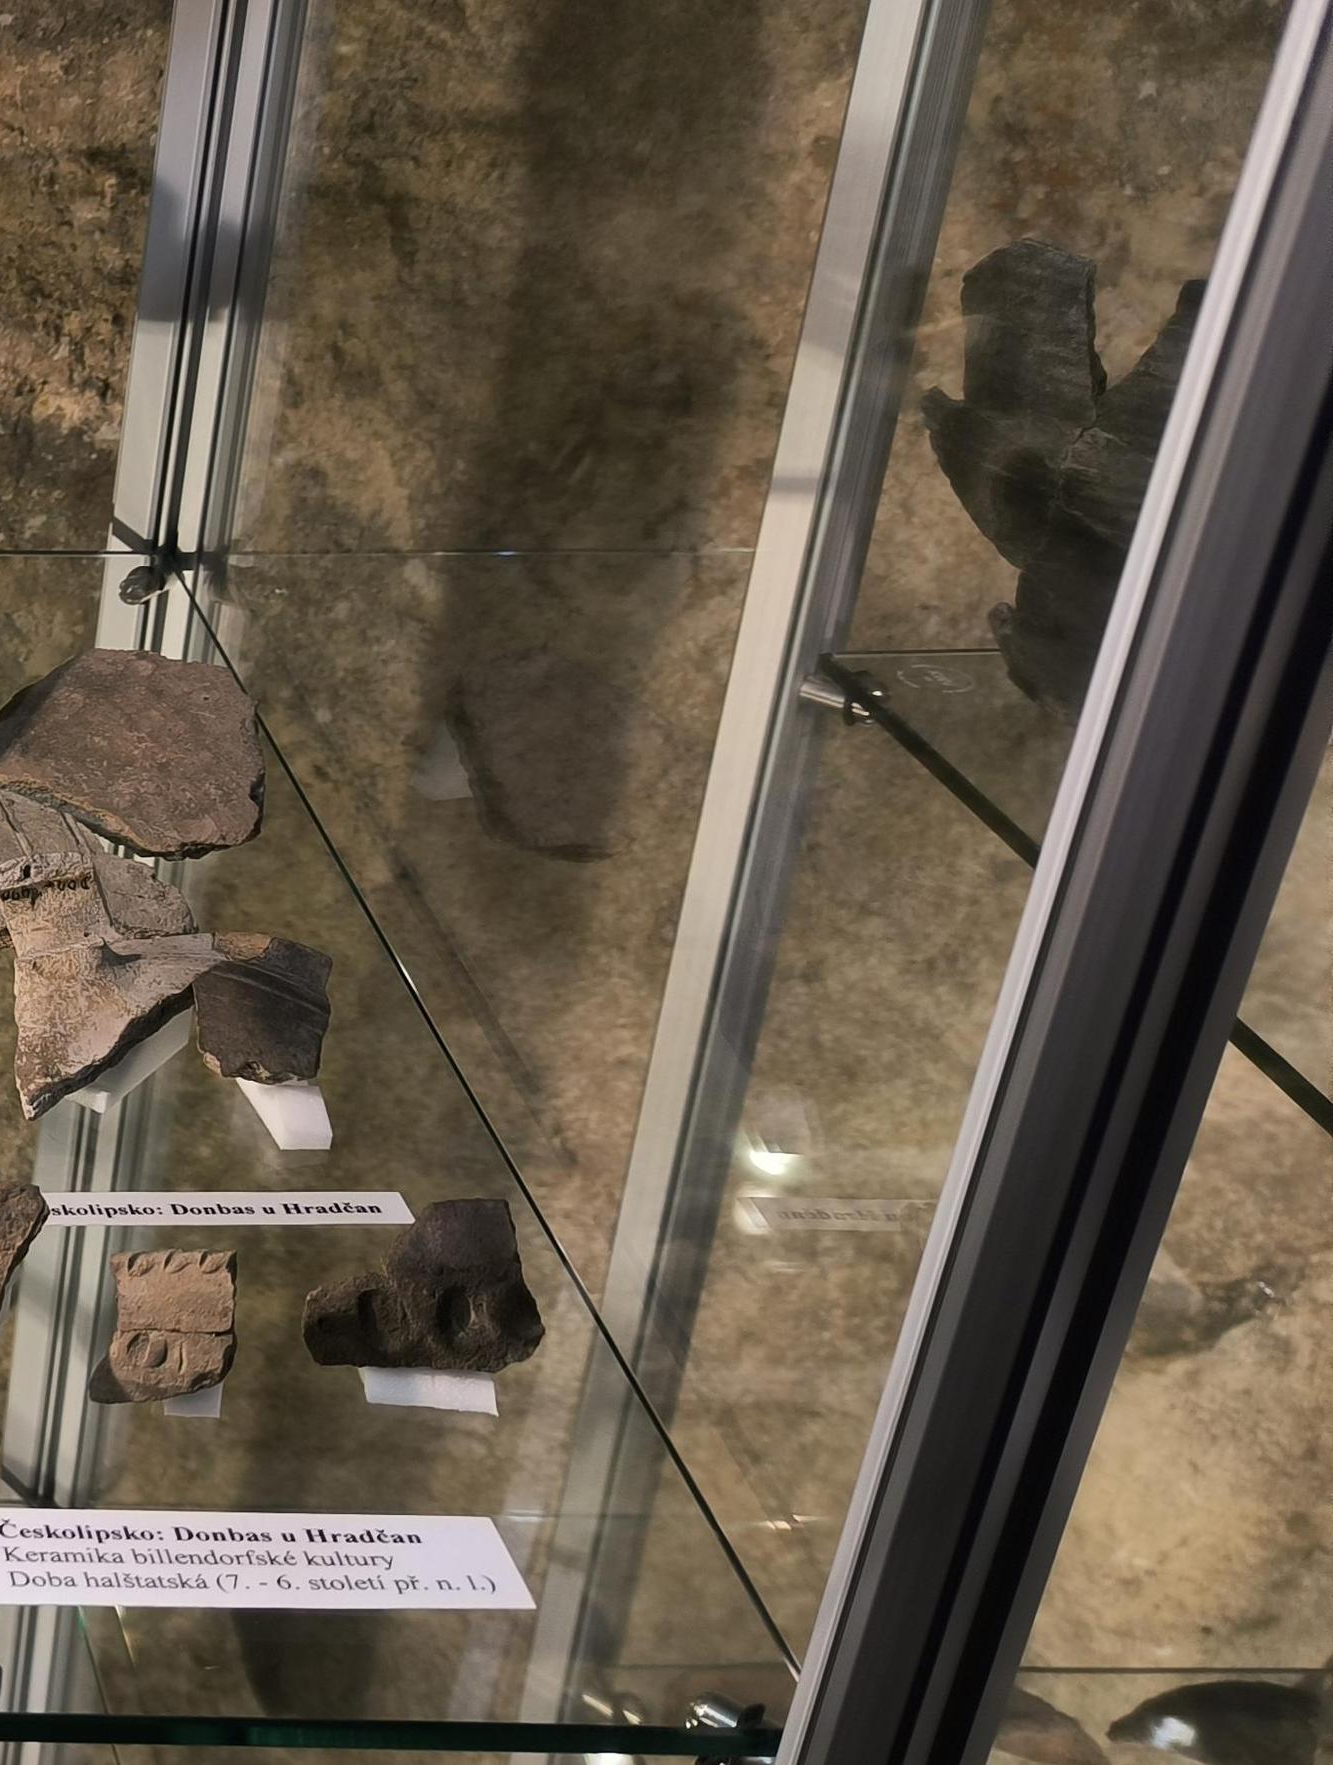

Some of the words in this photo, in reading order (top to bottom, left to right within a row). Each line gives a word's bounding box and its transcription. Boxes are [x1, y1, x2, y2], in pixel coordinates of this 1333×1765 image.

[51, 1203, 164, 1219] skolipsko:
[170, 1203, 256, 1216] Donbas
[261, 1206, 276, 1215] u
[281, 1202, 383, 1215] Hradčan
[173, 1526, 273, 1543] Donbas
[281, 1532, 297, 1543] u
[305, 1528, 422, 1544] Hradčan
[2, 1546, 125, 1564] Keramika
[130, 1548, 298, 1567] billendorfské
[302, 1550, 394, 1571] kultury
[9, 1570, 78, 1588] Doba
[83, 1571, 210, 1590] halštatská
[215, 1573, 250, 1593] (7.
[276, 1574, 300, 1591] 6.
[308, 1574, 386, 1591] století
[393, 1575, 429, 1595] př.
[435, 1579, 461, 1591] n.
[466, 1574, 497, 1594] l.)
